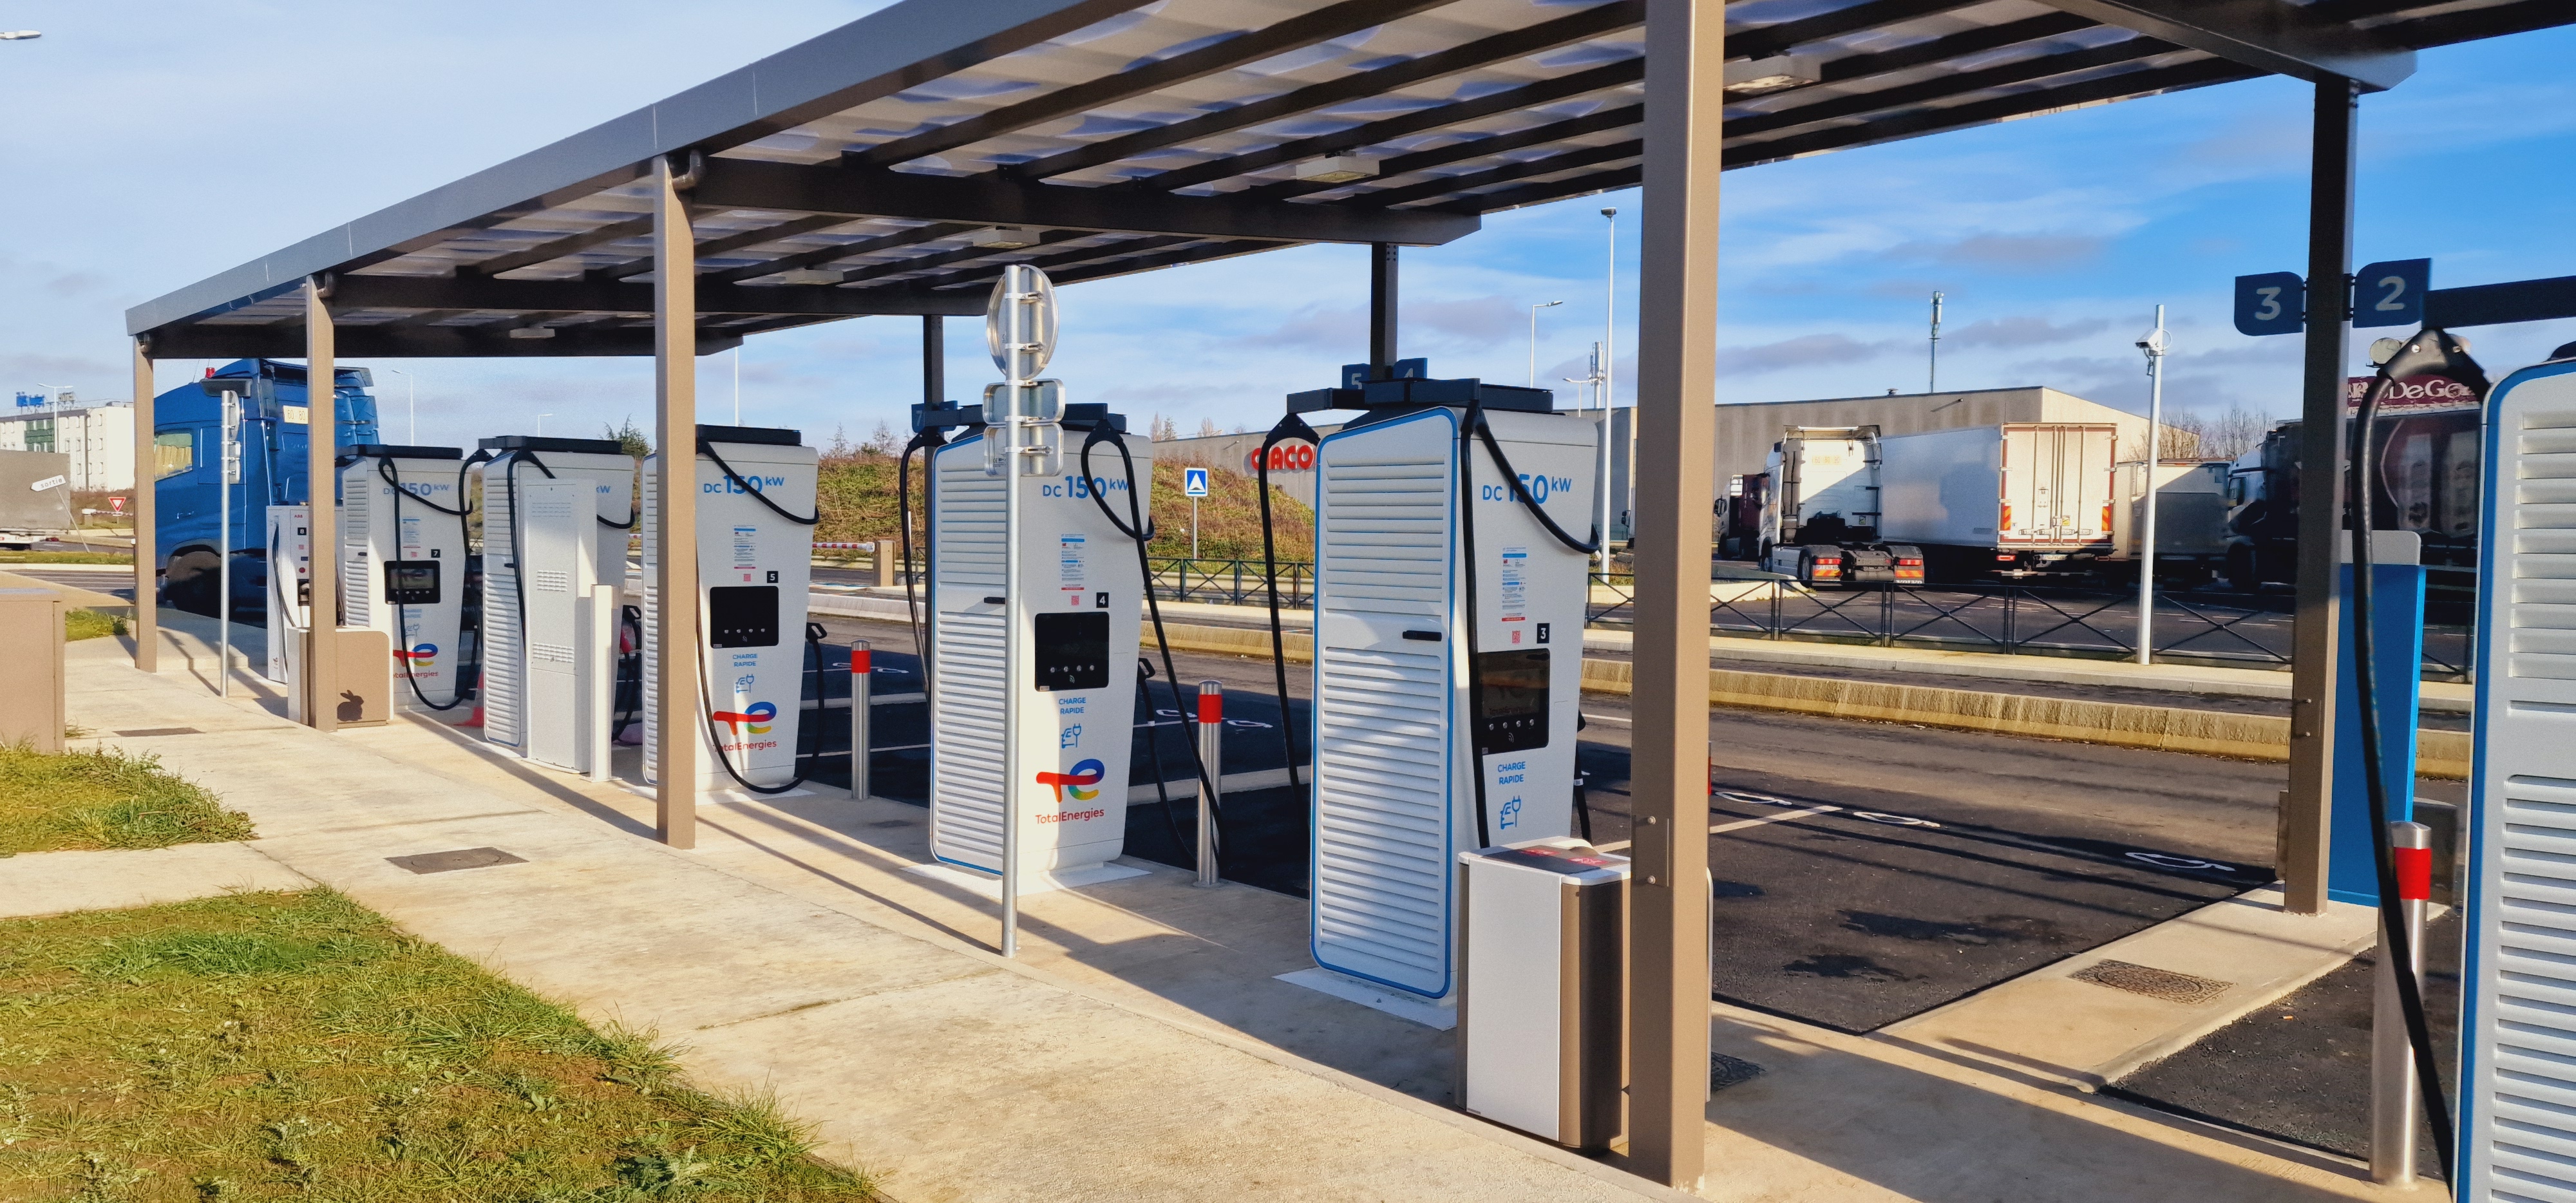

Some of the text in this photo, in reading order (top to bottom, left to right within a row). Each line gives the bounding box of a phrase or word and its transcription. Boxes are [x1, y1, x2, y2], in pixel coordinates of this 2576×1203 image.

[2376, 276, 2405, 310] 2
[2255, 287, 2281, 321] 3
[1352, 373, 1362, 390] 5
[916, 410, 923, 426] 7
[41, 477, 62, 488] sortie
[704, 475, 784, 494] DC 150 kW
[1043, 475, 1128, 498] DC 150 kW
[1483, 485, 1502, 501] DC
[1551, 476, 1572, 493] kW
[1099, 596, 1106, 605] 4
[1540, 628, 1546, 639] 3
[713, 740, 777, 753] otalEnergies
[1497, 761, 1526, 773] CHARGE
[1499, 774, 1524, 785] RAPIDE
[1036, 808, 1104, 824] TotalEnergies
